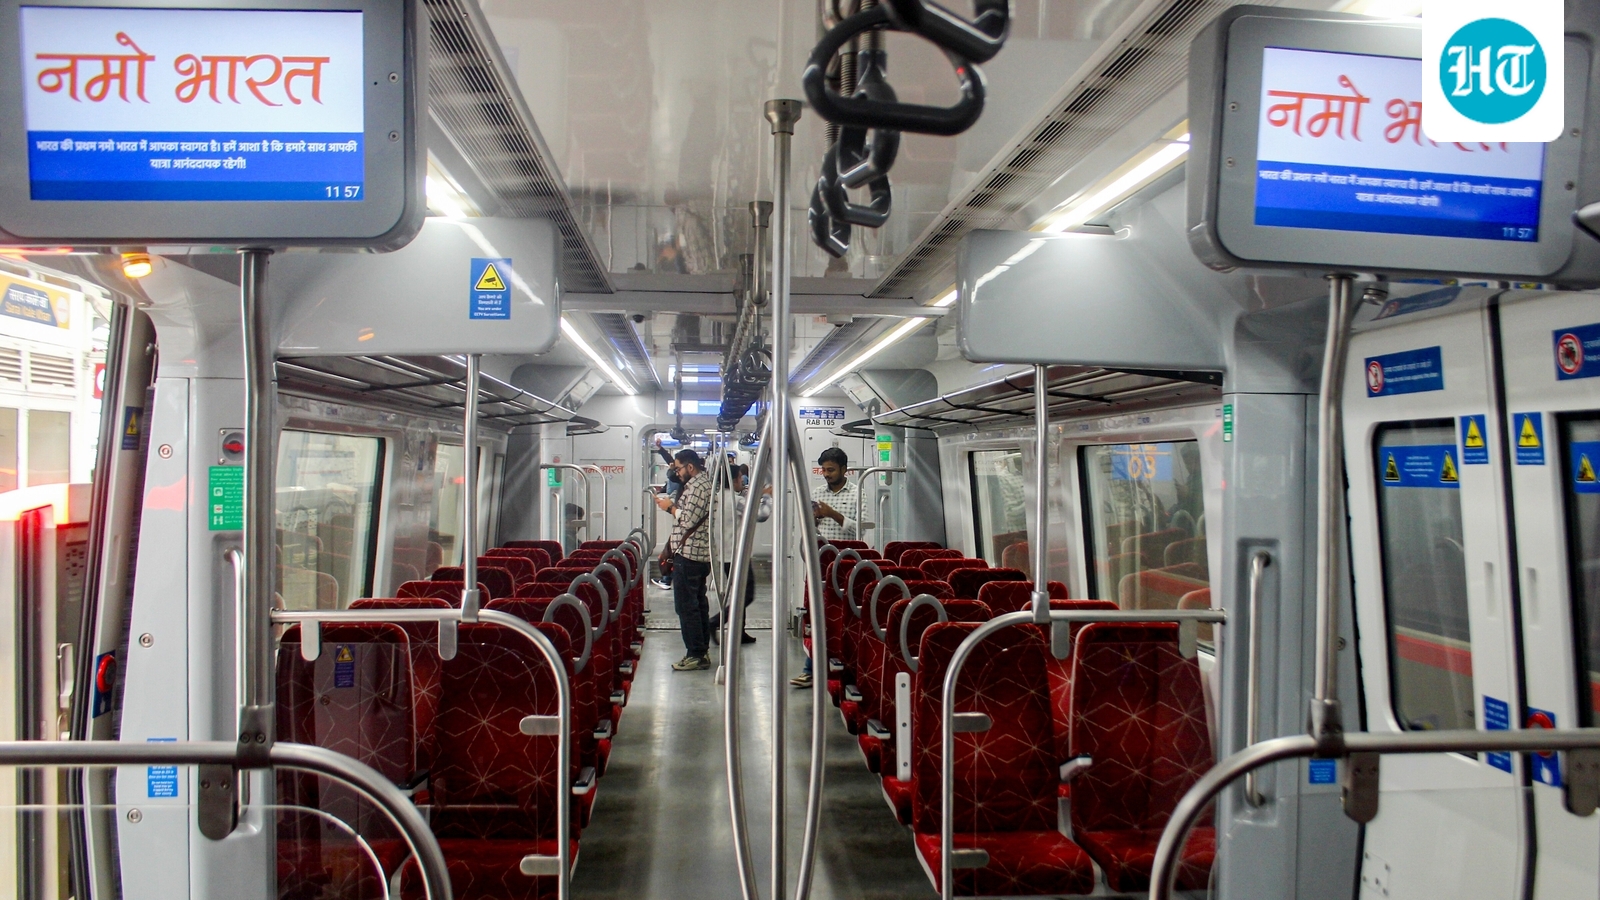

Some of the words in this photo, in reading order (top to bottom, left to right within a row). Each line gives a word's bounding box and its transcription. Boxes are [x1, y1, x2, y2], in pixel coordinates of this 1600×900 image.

[35, 31, 155, 103] नमो
[173, 53, 330, 106] भारत
[1267, 75, 1370, 143] नमो
[98, 139, 114, 152] नमो
[116, 141, 136, 152] भारत
[139, 139, 148, 152] में
[149, 141, 178, 152] आपका
[180, 141, 208, 152] स्वागत
[223, 139, 236, 152] हमें
[238, 141, 260, 152] आशा
[261, 139, 269, 152] है
[270, 140, 283, 152] कि
[285, 140, 306, 153] हमारे
[307, 142, 326, 153] साथ
[327, 140, 357, 153] आपकी
[150, 159, 171, 169] यात्रा
[173, 157, 221, 169] आनंददायक
[326, 186, 339, 198] 11
[344, 186, 360, 198] 57
[1128, 455, 1156, 479] 03
